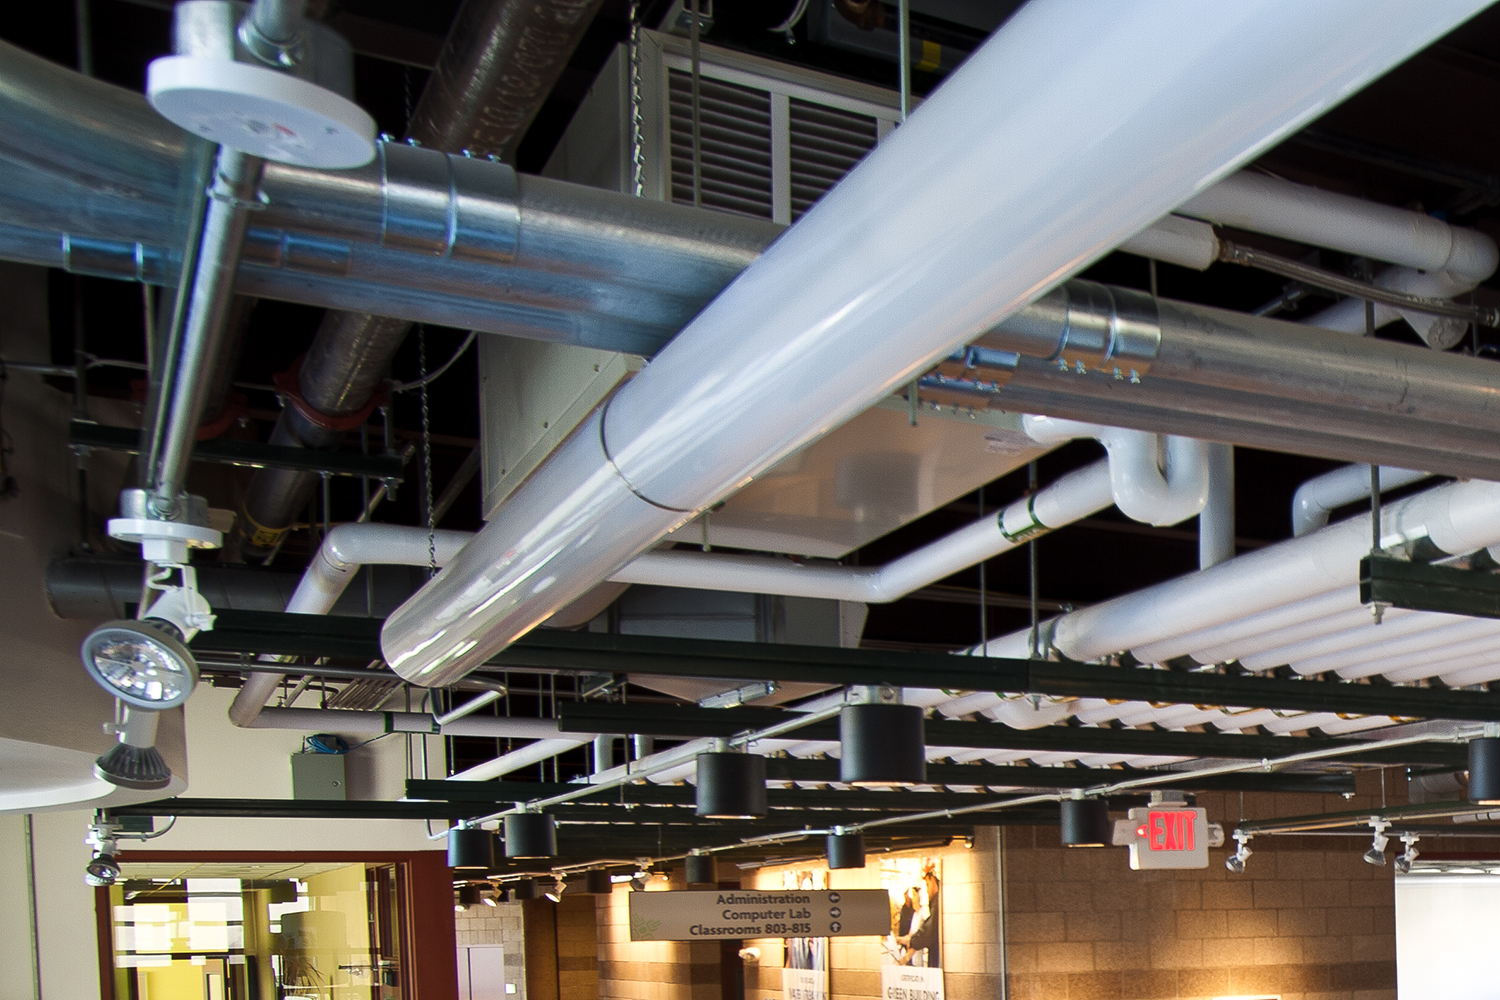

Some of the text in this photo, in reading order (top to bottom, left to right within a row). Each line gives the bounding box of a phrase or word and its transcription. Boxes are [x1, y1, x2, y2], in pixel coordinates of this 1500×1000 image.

[1148, 811, 1196, 850] EXIT
[716, 894, 810, 904] Administration
[722, 909, 811, 922] Computer Lab
[690, 924, 811, 936] Classrooms 803-815
